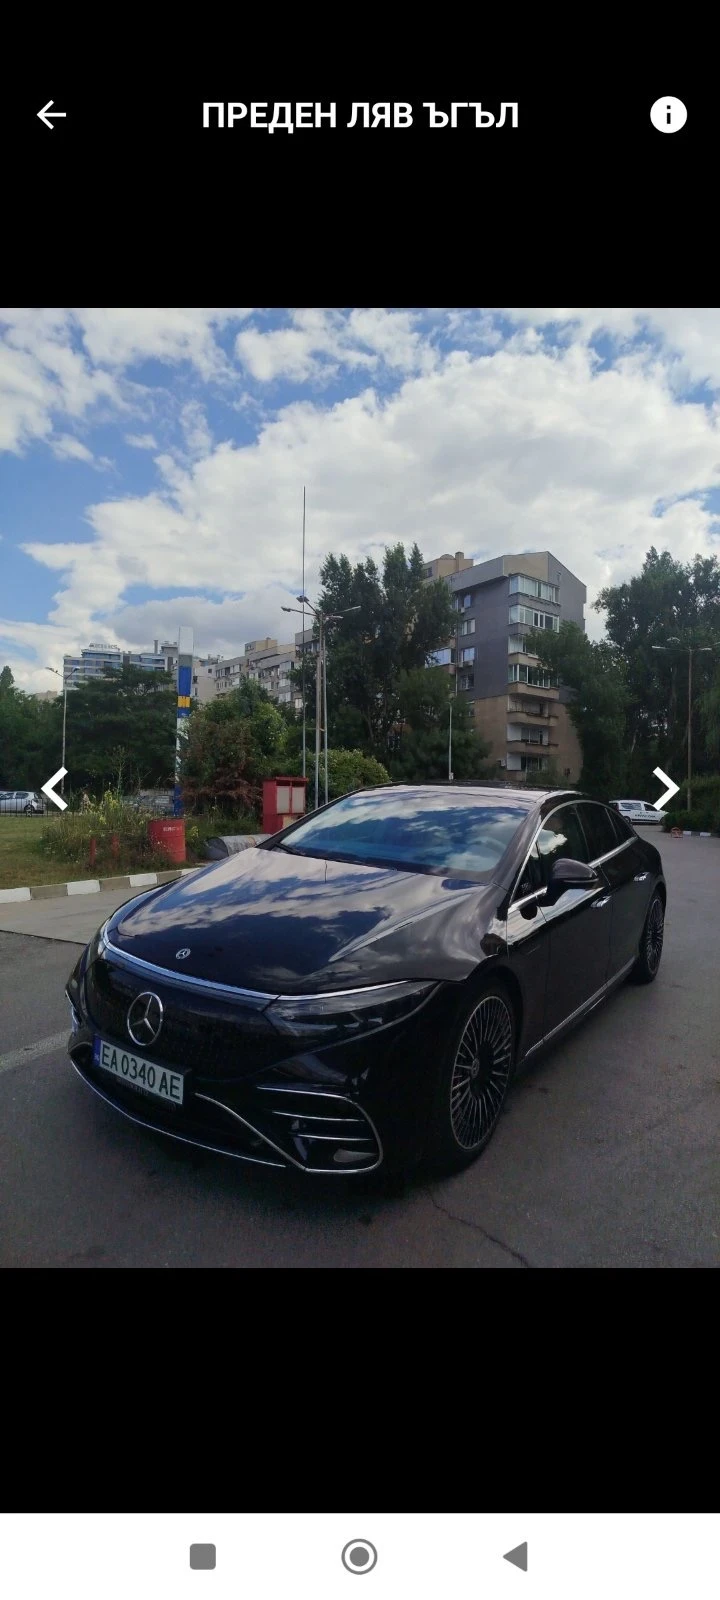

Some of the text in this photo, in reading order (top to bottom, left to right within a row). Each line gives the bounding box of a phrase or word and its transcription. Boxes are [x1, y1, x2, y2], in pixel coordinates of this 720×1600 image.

[101, 1043, 118, 1072] EA
[121, 1054, 156, 1089] 0340
[159, 1071, 181, 1100] AE
